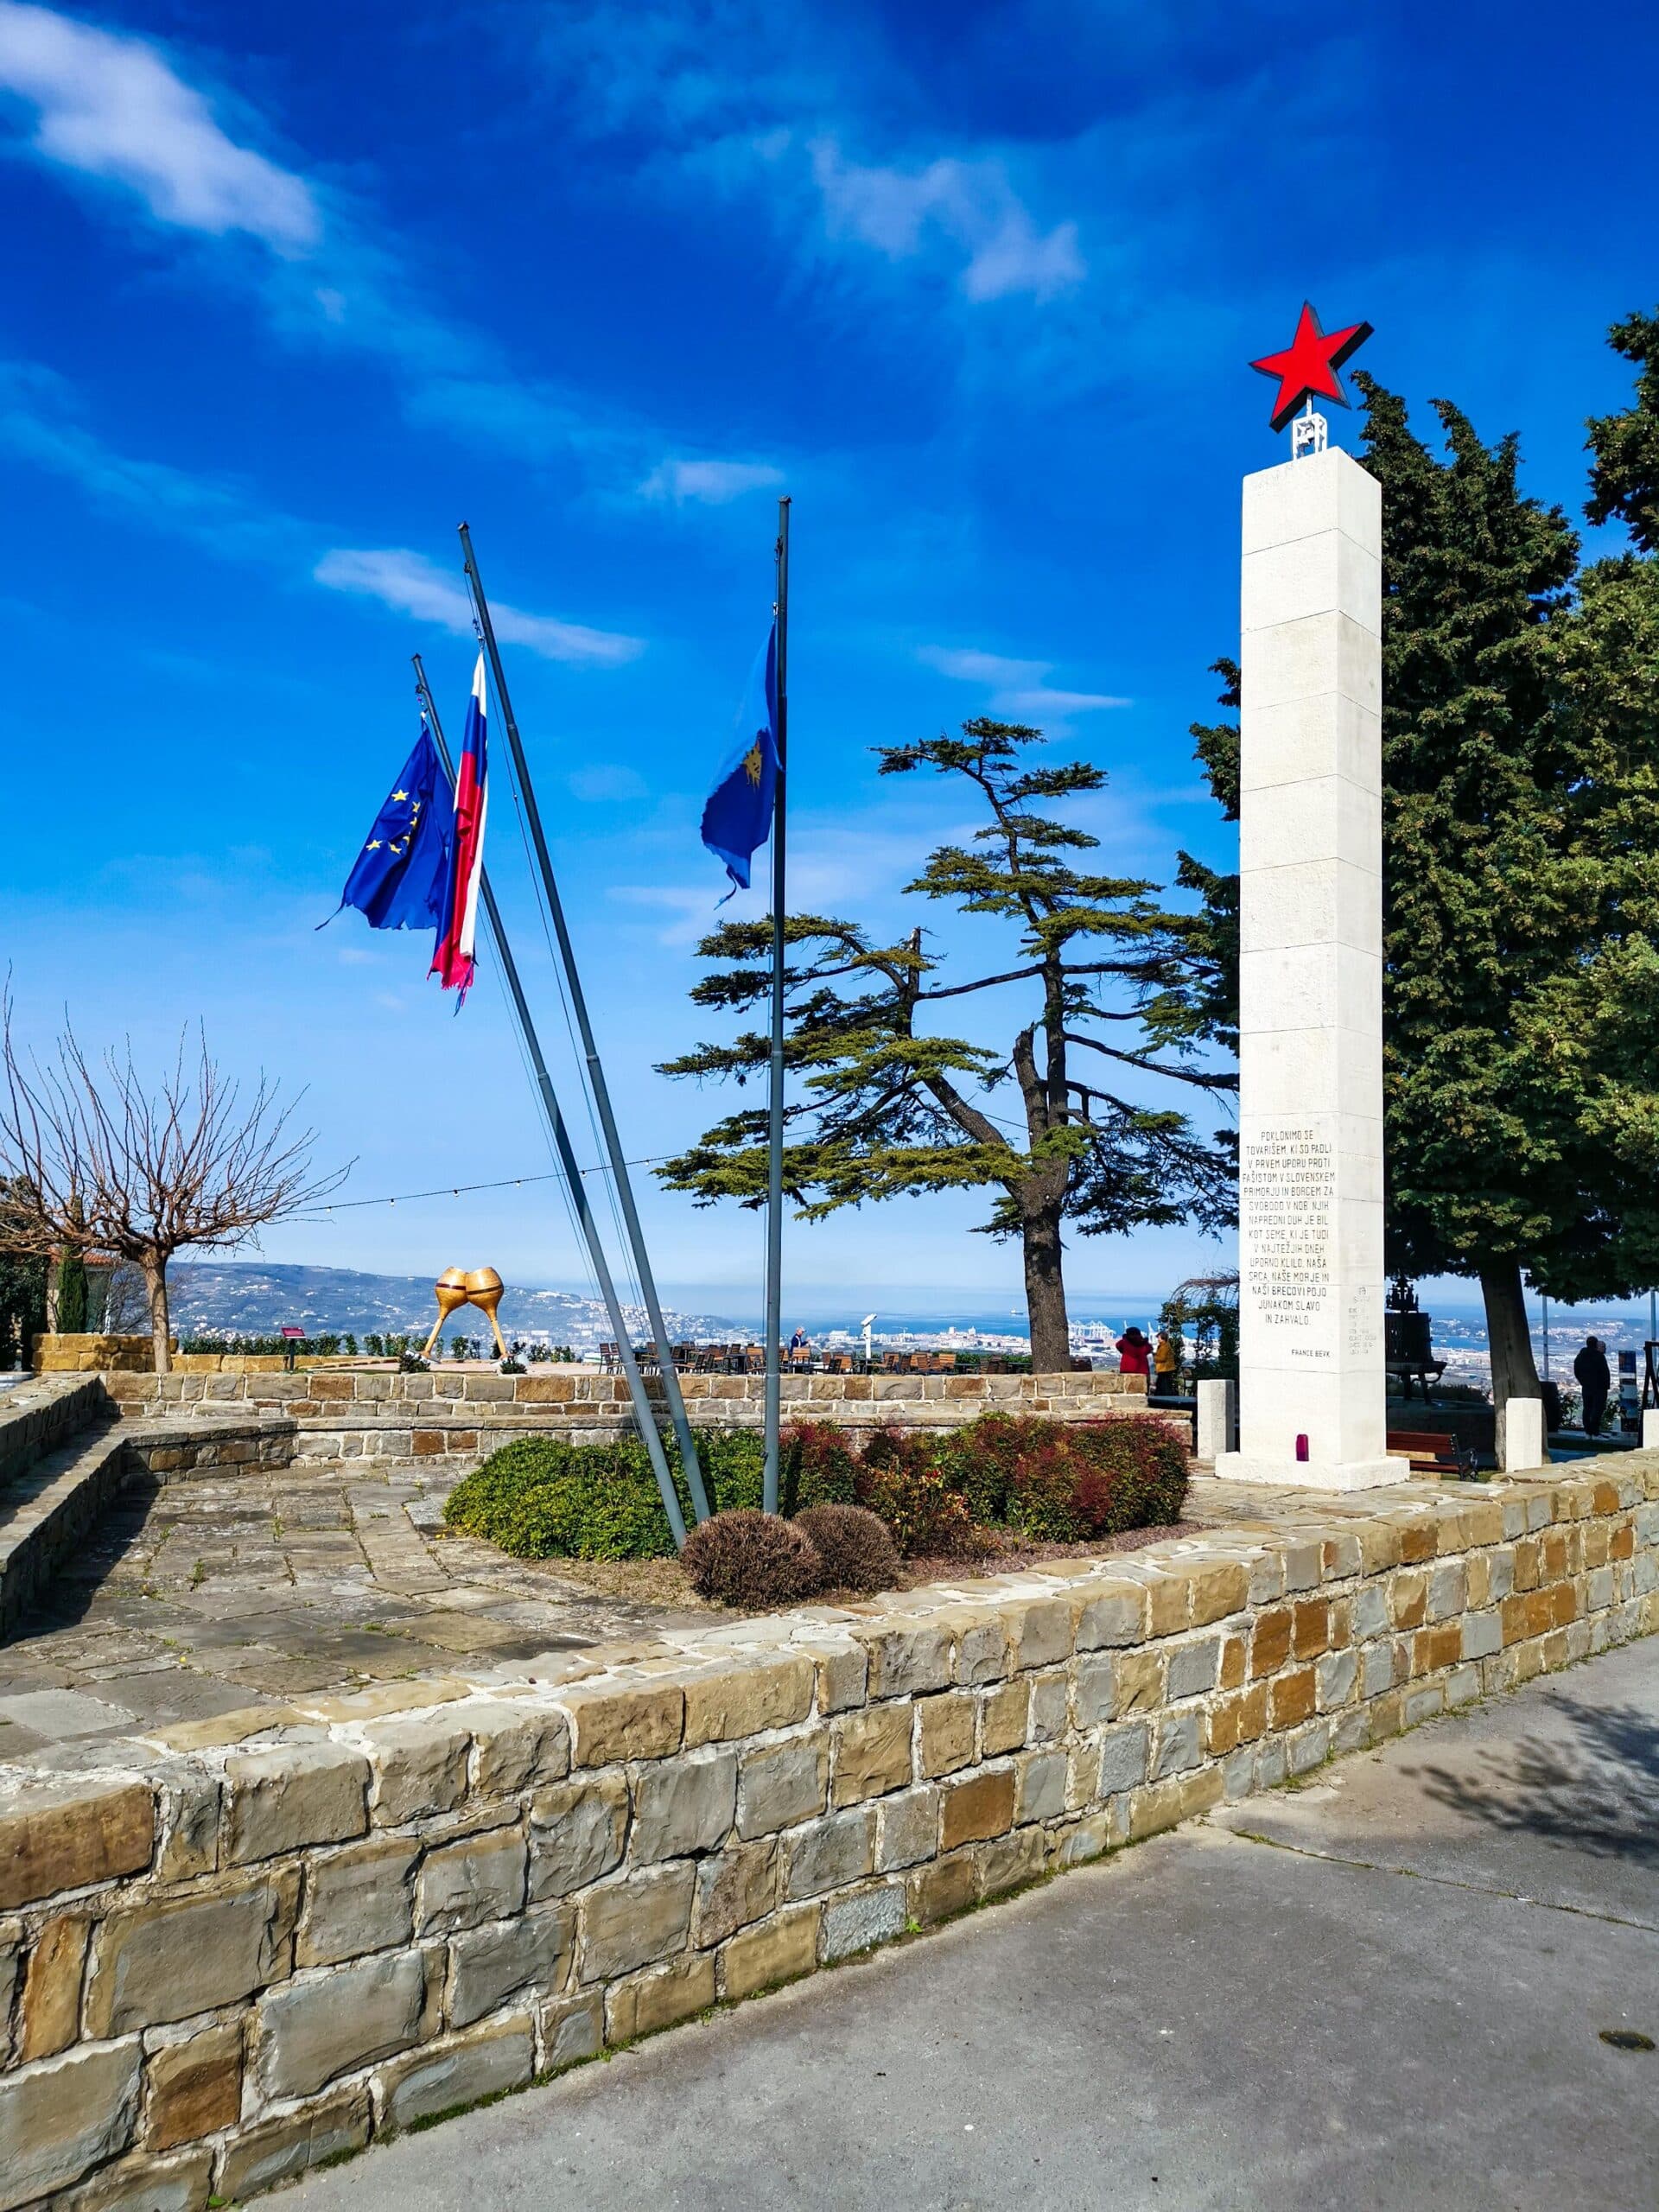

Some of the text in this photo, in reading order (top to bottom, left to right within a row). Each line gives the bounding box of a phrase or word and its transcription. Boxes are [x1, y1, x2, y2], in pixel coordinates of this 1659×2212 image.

[1262, 1129, 1313, 1141] POKLONIMO SE
[1290, 1144, 1298, 1154] KI
[1300, 1144, 1309, 1154] SO
[1311, 1142, 1332, 1154] PADLI
[1248, 1158, 1331, 1169] V PRVEM UPORU PROTI
[1242, 1170, 1335, 1183] FAŠISTOM V SLOVENSKEM
[1243, 1185, 1334, 1197] PRIMORJU IN BORCEM ZA
[1249, 1201, 1284, 1211] SVOBODO
[1286, 1201, 1291, 1211] V
[1313, 1201, 1329, 1211] NJIH
[1249, 1215, 1330, 1225] NAPREDNI DUH JE BIL
[1249, 1230, 1263, 1239] KOT
[1289, 1230, 1298, 1240] KI
[1300, 1230, 1309, 1240] JE
[1312, 1230, 1329, 1240] TUDI
[1254, 1241, 1325, 1254] V NAJTEŽJIH DNEH
[1249, 1257, 1279, 1268] UPORNO
[1306, 1255, 1327, 1268] NAŠA
[1272, 1269, 1292, 1282] NAŠE
[1294, 1272, 1320, 1283] MORJE
[1322, 1272, 1330, 1282] IN
[1252, 1283, 1270, 1295] NAŠI
[1306, 1287, 1327, 1298] POJO
[1258, 1300, 1320, 1312] JUNAKOM SLAVO
[1265, 1313, 1273, 1324] IN
[1291, 1349, 1331, 1358] FRANCE BEVK
